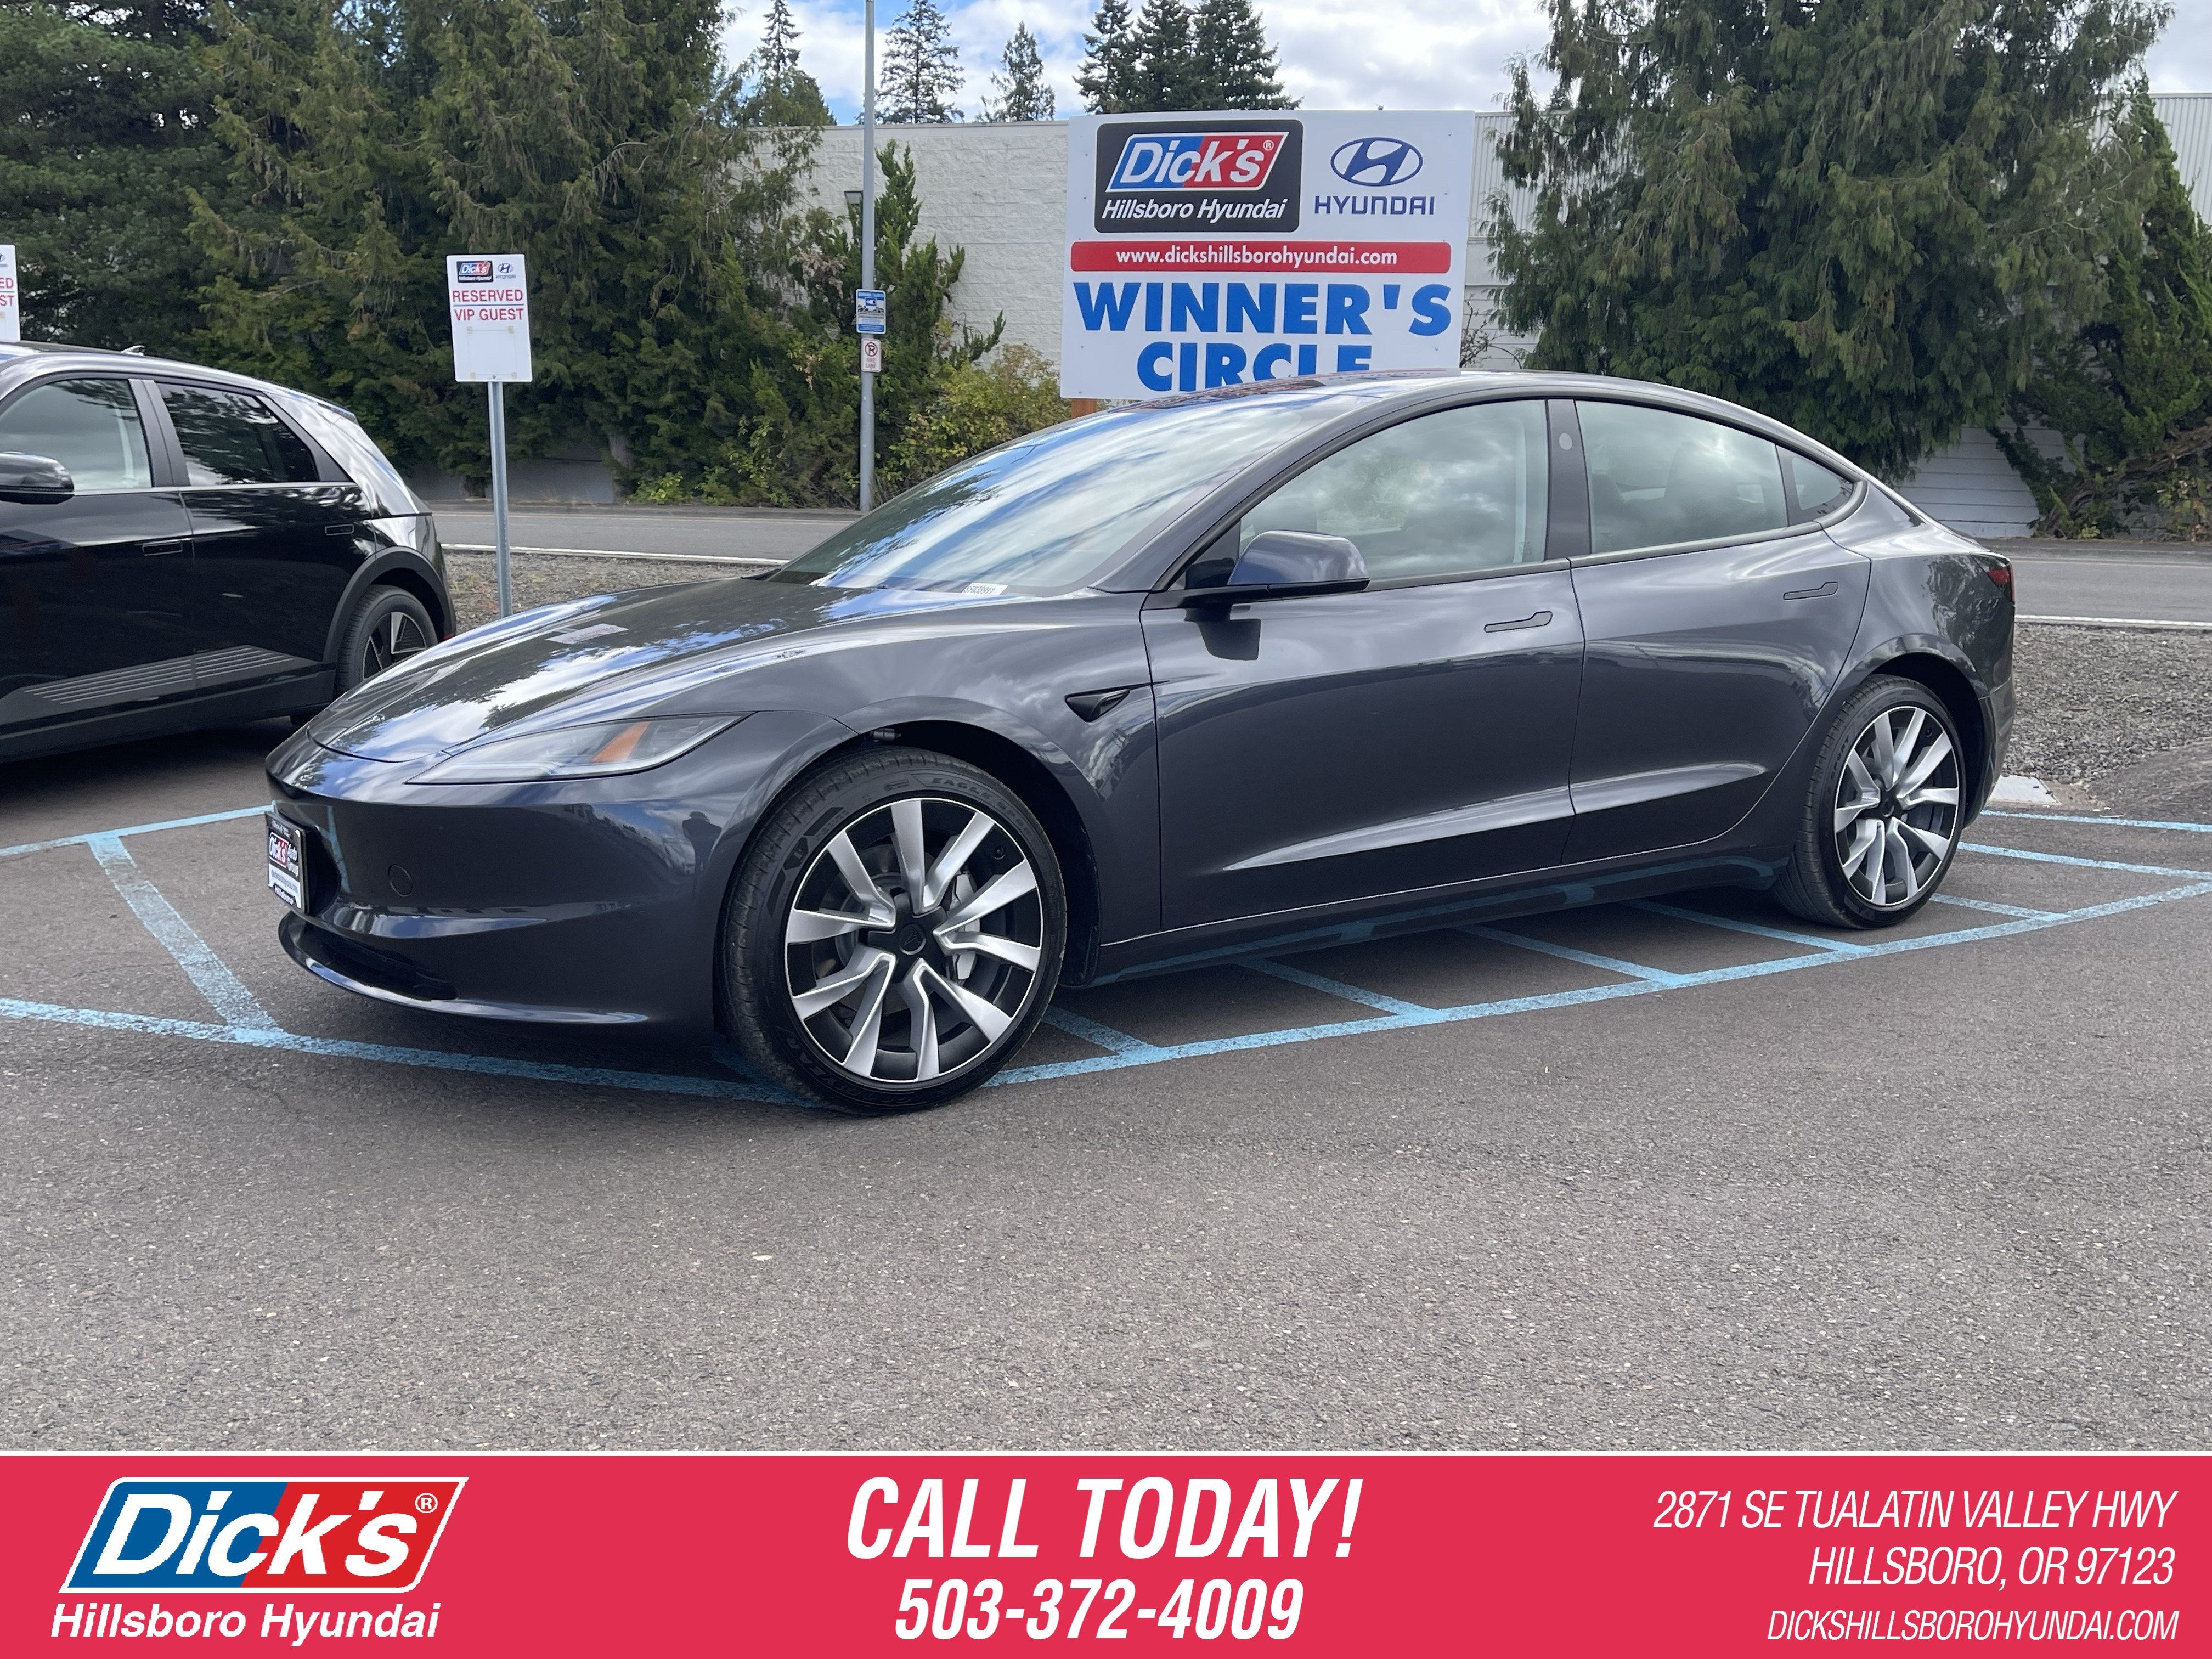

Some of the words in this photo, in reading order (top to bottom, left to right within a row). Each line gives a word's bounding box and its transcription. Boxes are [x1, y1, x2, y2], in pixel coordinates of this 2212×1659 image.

[1102, 199, 1194, 219] Hillsboro
[1197, 199, 1288, 223] Hyundai
[1314, 196, 1434, 215] HYUNDAI
[1116, 245, 1397, 269] www.dickshillsborohyundai.com
[452, 289, 523, 302] RESERVED
[454, 308, 475, 320] VIP
[479, 308, 524, 320] GUEST
[1074, 282, 1451, 336] WINNER'S
